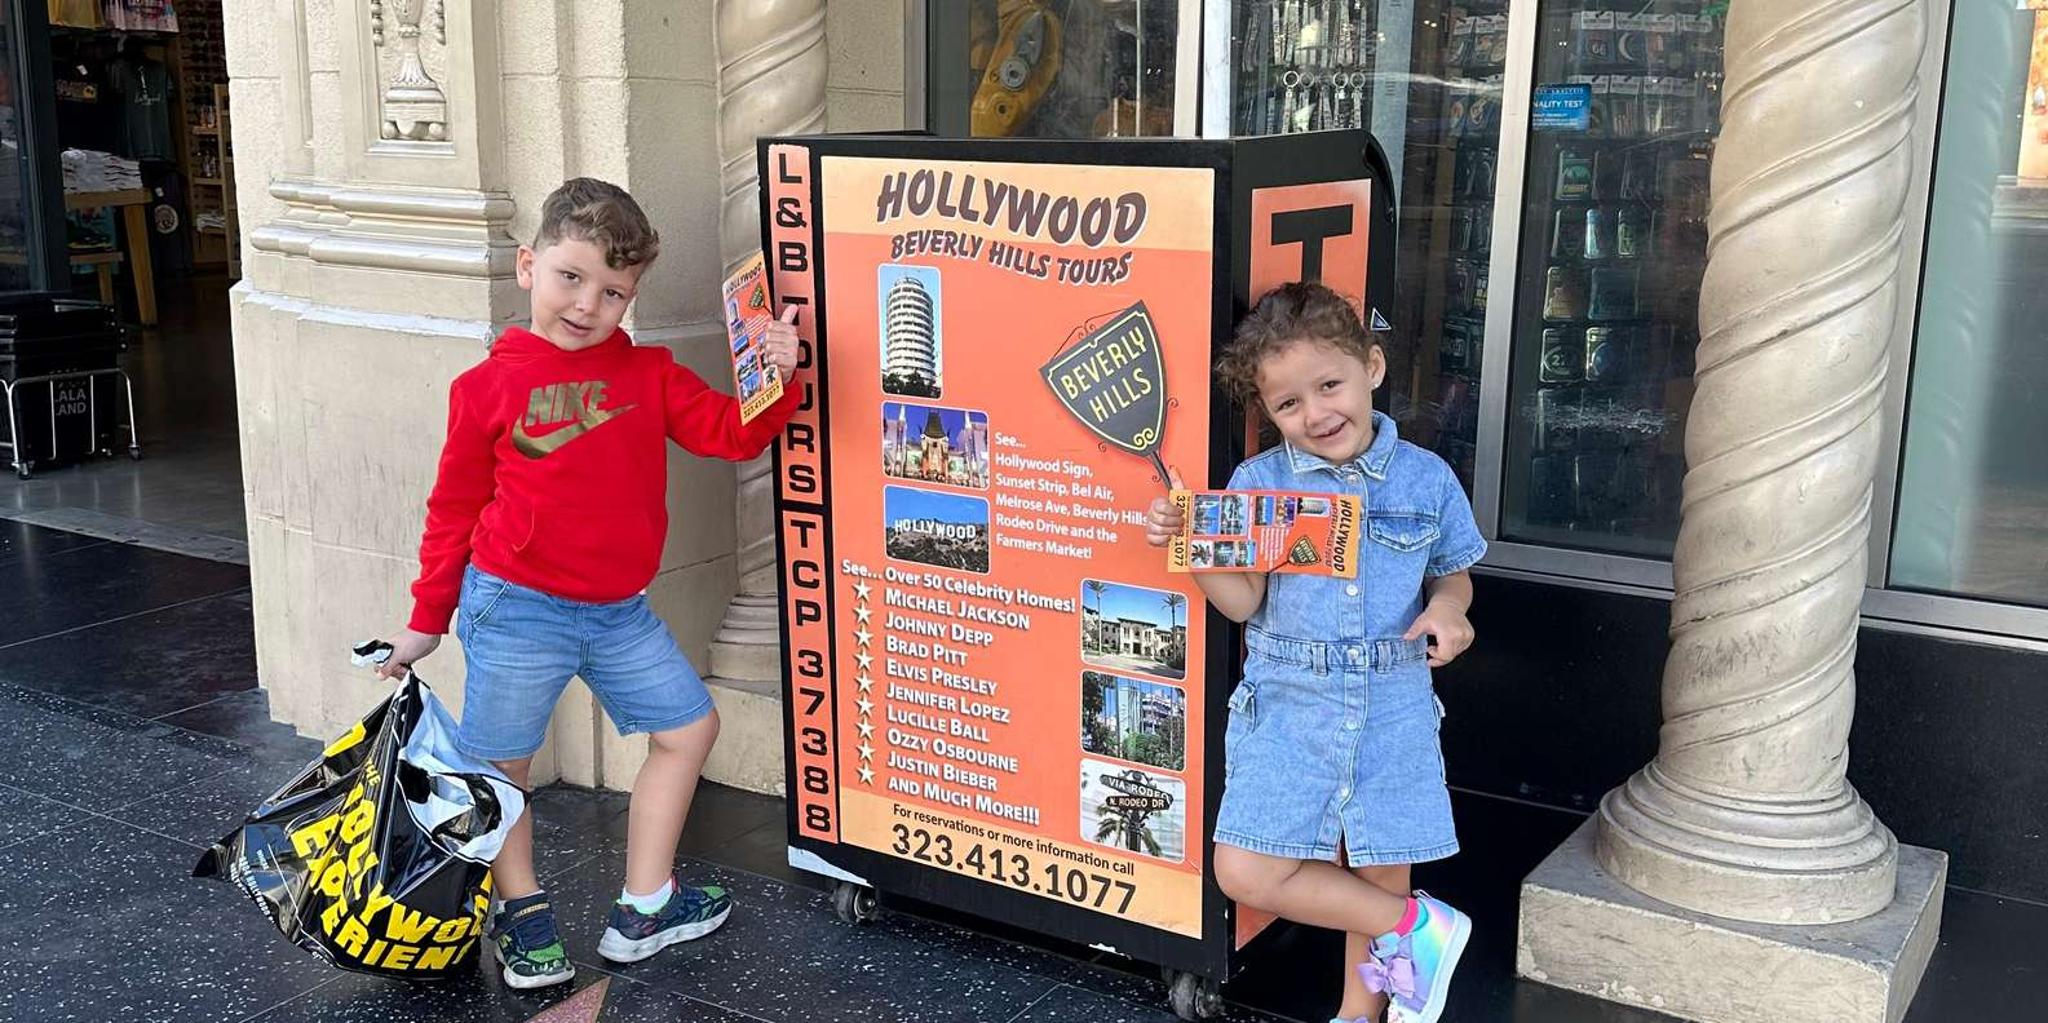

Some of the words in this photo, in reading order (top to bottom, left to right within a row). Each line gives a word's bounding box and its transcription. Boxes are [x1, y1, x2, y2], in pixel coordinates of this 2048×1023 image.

[1564, 100, 1584, 108] TEST
[877, 169, 1147, 247] HOLLYWOOD
[891, 230, 983, 259] BEVERLY
[989, 241, 1050, 278] HILLS
[1057, 251, 1132, 284] TOURS
[1060, 326, 1146, 400] BEVERLY
[55, 389, 86, 402] ALA
[56, 402, 87, 416] AND
[525, 381, 609, 427] NIKE
[1089, 368, 1151, 422] HILLS
[995, 432, 1026, 448] See...
[995, 453, 1060, 473] Hollywood
[1062, 461, 1094, 479] Sign,
[995, 474, 1035, 490] Sunset
[1037, 478, 1069, 497] Strip,
[1072, 483, 1091, 499] Bel
[1094, 486, 1115, 502] Air,
[894, 518, 977, 539] HOLLYWOOD
[996, 493, 1042, 512] Melrose
[1045, 500, 1070, 517] Ave,
[1073, 504, 1119, 525] Beverly
[996, 513, 1034, 530] Rodeo
[1037, 519, 1069, 535] Drive
[1071, 525, 1094, 539] and
[1097, 528, 1117, 543] the
[996, 534, 1043, 552] Farmers
[1046, 542, 1092, 559] Market!
[1333, 499, 1353, 572] HOLLYWOOD
[790, 520, 821, 627] TCP
[885, 566, 920, 586] Over
[924, 573, 942, 590] 50
[945, 577, 1013, 605] Celebrity
[1016, 588, 1076, 613] Homes!
[886, 588, 954, 616] MICHAEL
[958, 600, 1030, 629] JACKSON
[885, 611, 947, 638] JOHNNY
[951, 624, 994, 647] DEPP
[886, 635, 929, 658] BRAD
[933, 644, 969, 666] PITT
[886, 658, 927, 682] ELVIS
[932, 667, 998, 696] PRESLEY
[886, 682, 957, 712] JENNIFER
[960, 697, 1011, 723] LOPEZ
[798, 650, 831, 833] 37388
[887, 704, 947, 733] LUCILLE
[950, 718, 991, 743] BALL
[887, 728, 929, 751] OZZY
[933, 738, 1019, 773] OSBOURNE
[365, 757, 381, 786] THE
[888, 751, 939, 777] JUSTIN
[943, 764, 998, 791] BIEBER
[1109, 777, 1126, 790] VIA
[924, 782, 971, 808] MUCH
[975, 794, 1040, 825] MORE!!!
[1119, 798, 1148, 807] RODEO
[1152, 799, 1165, 808] DR
[893, 803, 912, 818] For
[914, 811, 985, 837] reservations
[987, 829, 1001, 841] or
[1003, 833, 1034, 850] more
[1036, 840, 1109, 869] information
[1112, 861, 1135, 876] call
[892, 823, 1137, 914] 323.413.1077
